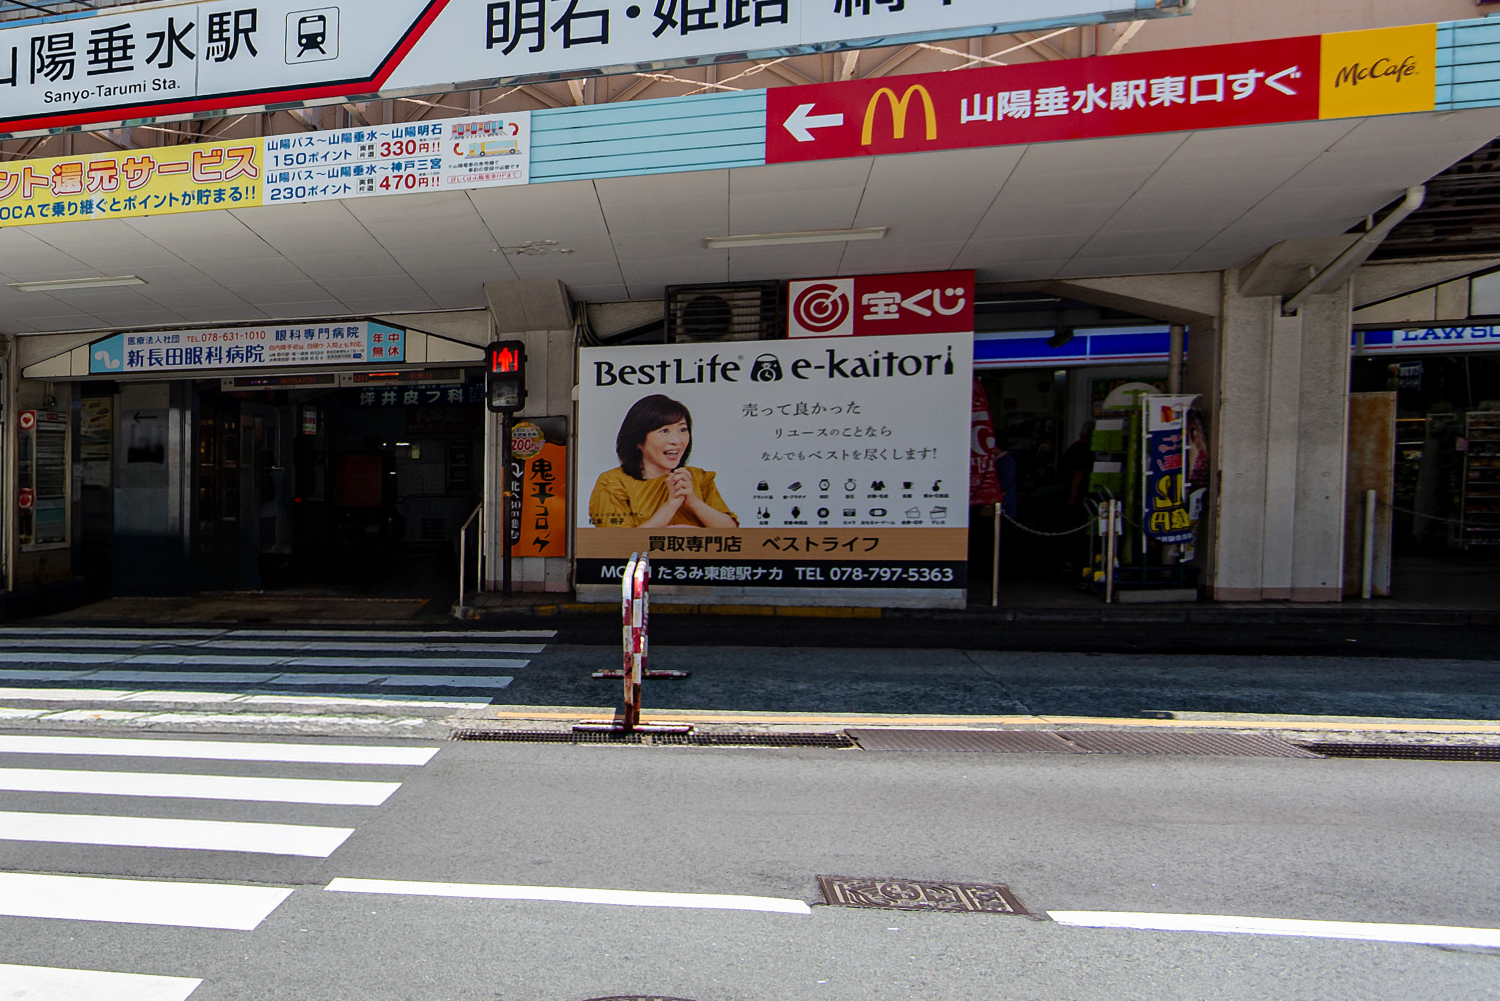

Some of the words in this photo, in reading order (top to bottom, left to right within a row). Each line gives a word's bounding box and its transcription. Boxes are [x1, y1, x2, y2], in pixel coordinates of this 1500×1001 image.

[1334, 55, 1418, 89] McCafé
[44, 80, 147, 105] Sanyo-Tarumi
[152, 77, 181, 91] Sta.
[960, 64, 1302, 124] 山陽垂水駅東口すぐ
[273, 148, 352, 167] 150ポイント
[270, 183, 352, 201] 230ポイント
[862, 287, 965, 321] 宝くじ
[127, 335, 181, 346] 医療法人社団
[275, 326, 360, 342] 眼科専門病院
[127, 343, 266, 368] 新長田眼科病院
[593, 354, 741, 387] BestLife
[791, 345, 954, 380] e-kaitori
[359, 388, 465, 406] 坪井皮フ科
[742, 401, 861, 417] 売って良かった
[775, 426, 892, 439] リユースのことなら
[531, 458, 556, 553] 鬼平コロッケ
[648, 535, 742, 553] 買取専門店
[761, 536, 880, 552] ベストライフ
[657, 565, 783, 581] たるみ東館駅ナカ
[794, 567, 824, 580] TEL
[829, 567, 954, 582] 078-797-5363
